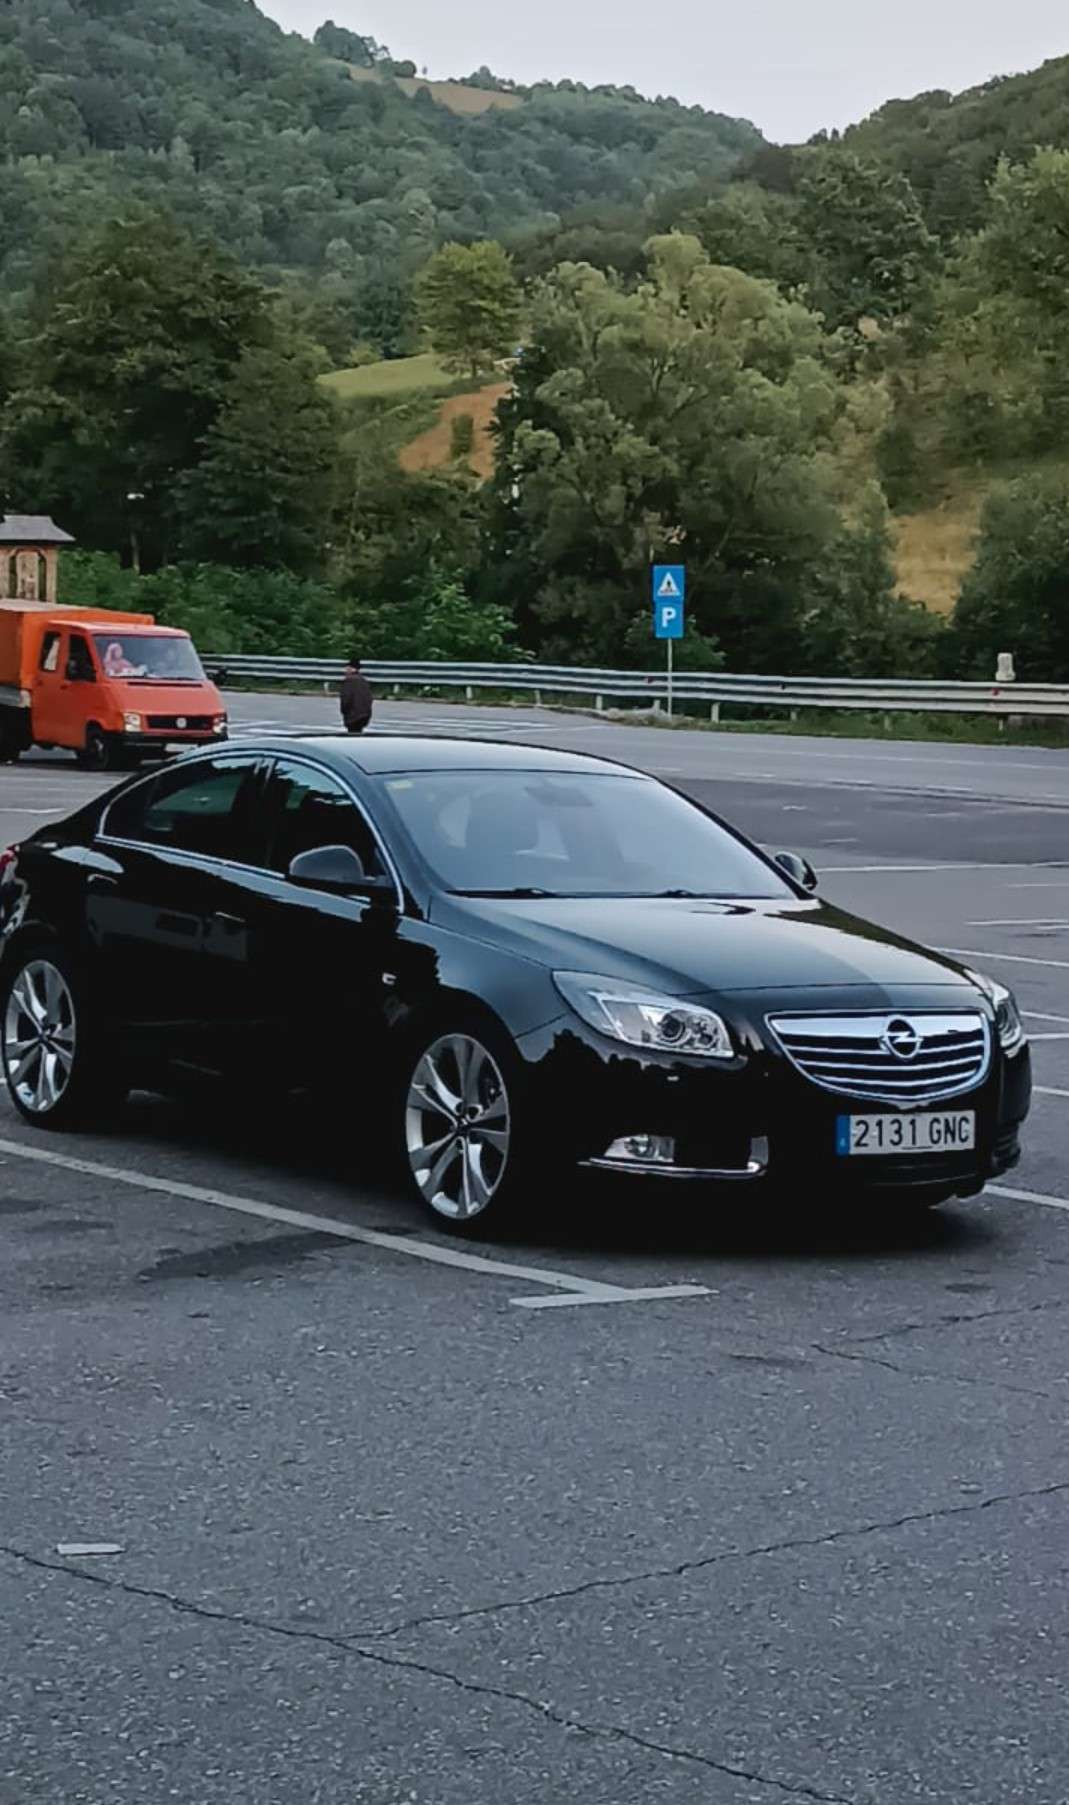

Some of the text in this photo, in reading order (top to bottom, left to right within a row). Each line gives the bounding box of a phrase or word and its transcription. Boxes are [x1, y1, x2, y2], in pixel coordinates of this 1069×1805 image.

[662, 606, 677, 628] P
[854, 1115, 969, 1147] 2131 GNC
